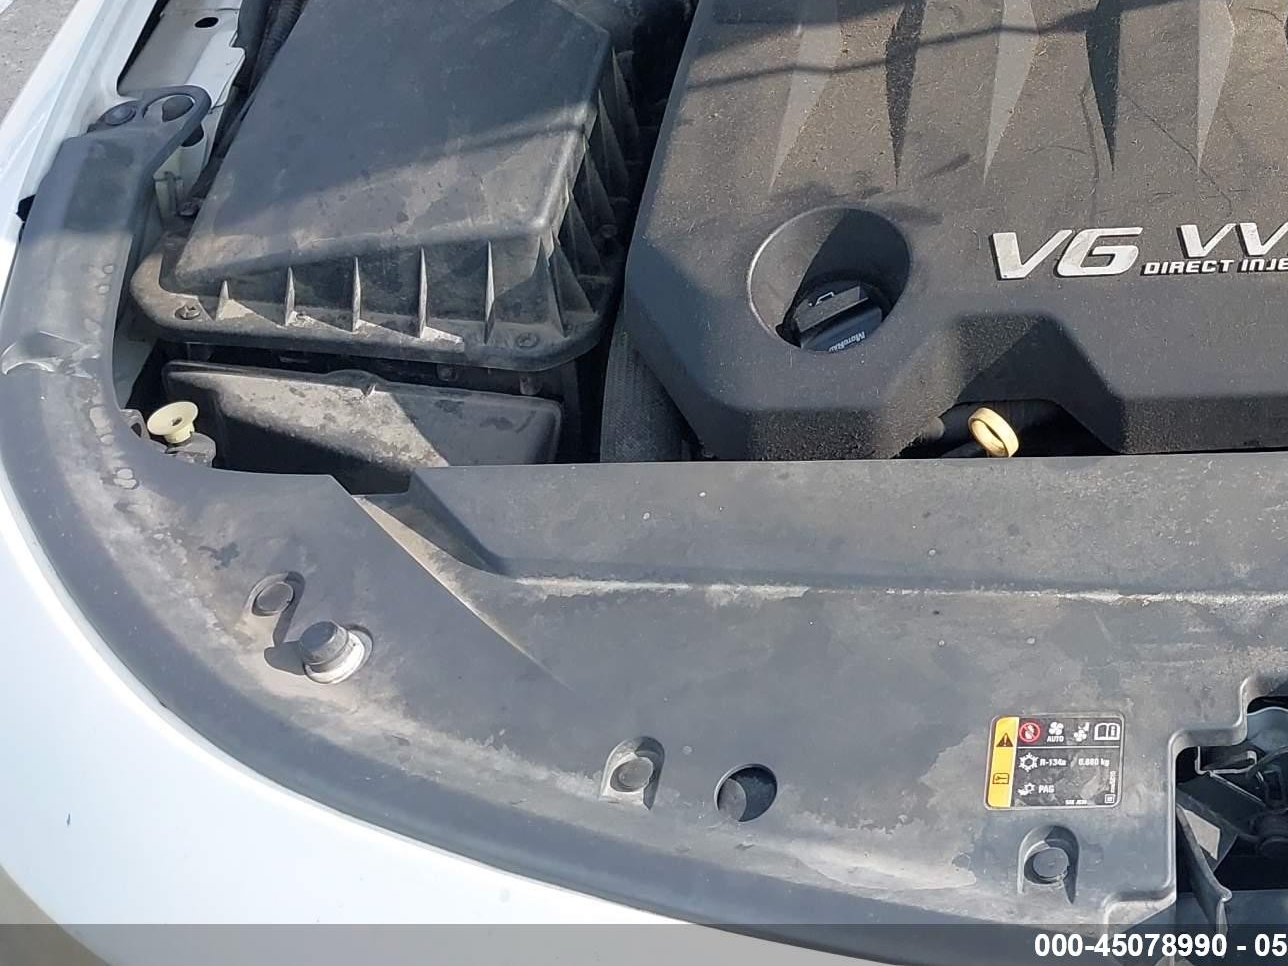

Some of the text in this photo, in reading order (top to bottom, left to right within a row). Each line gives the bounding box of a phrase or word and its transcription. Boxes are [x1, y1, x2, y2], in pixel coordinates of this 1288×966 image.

[991, 226, 1144, 280] V6
[1142, 259, 1235, 275] DIRECT
[1040, 758, 1066, 766] R-134a
[1101, 758, 1110, 767] kg
[1038, 785, 1055, 793] PAG
